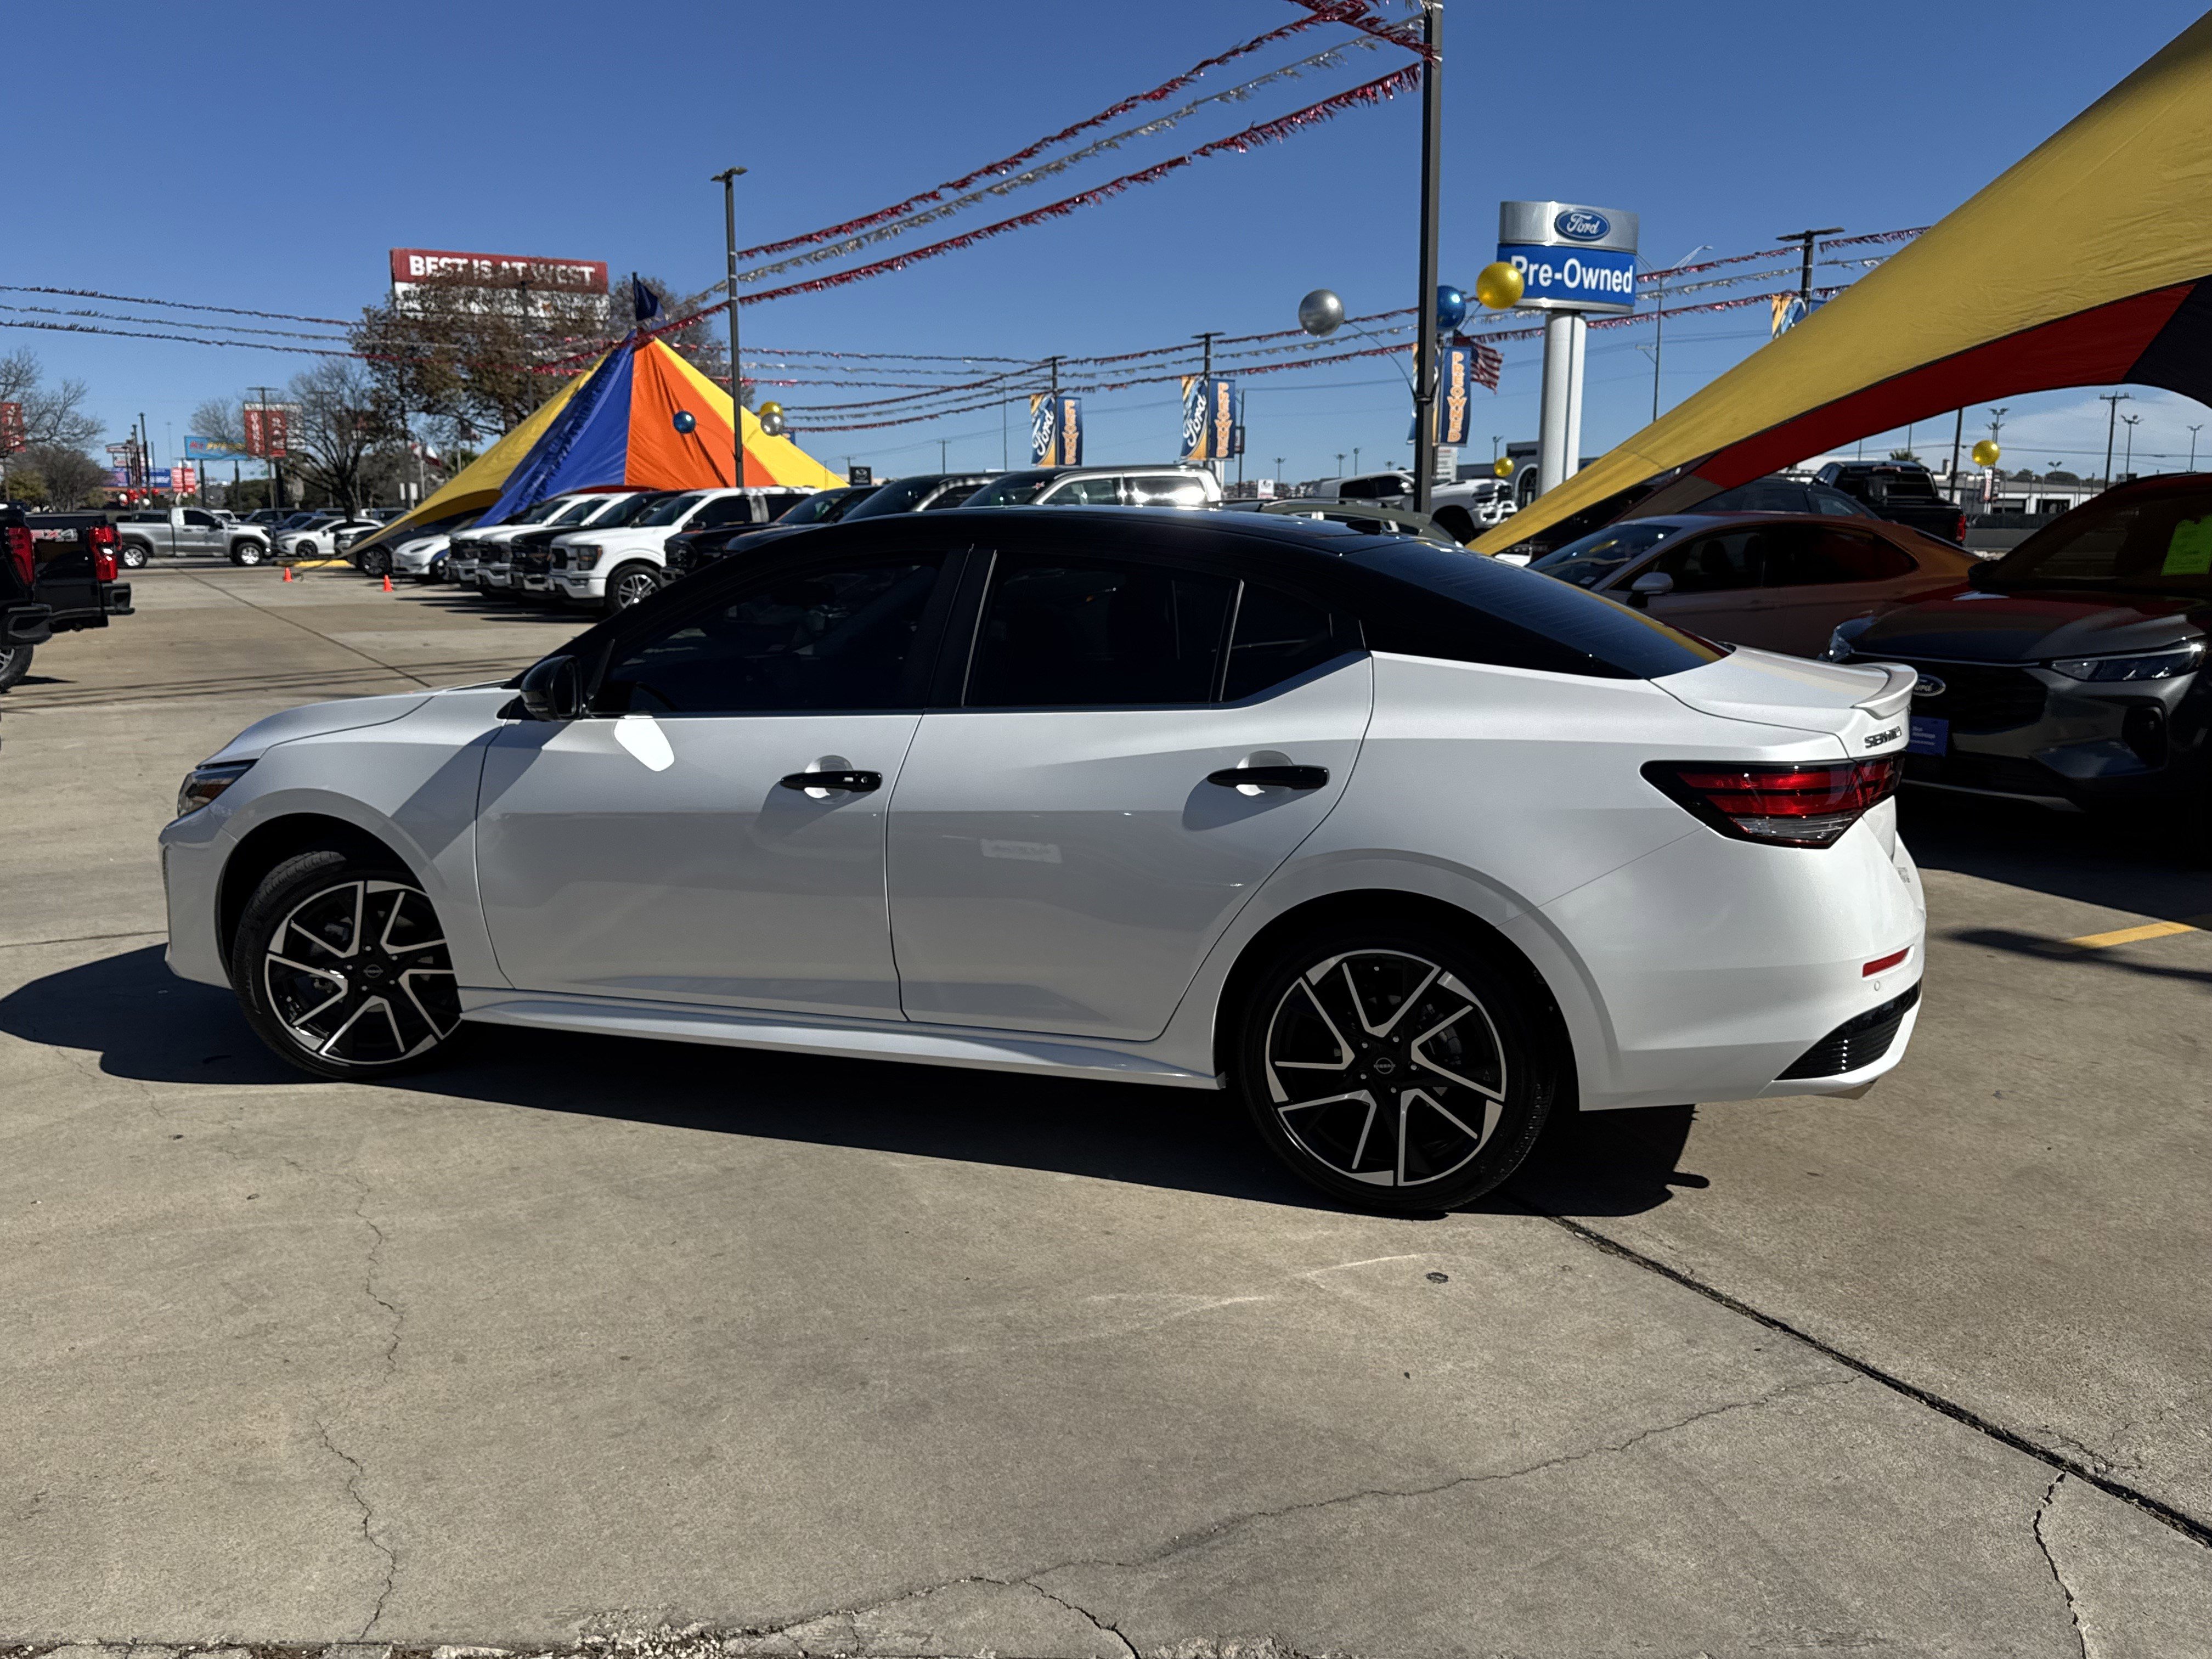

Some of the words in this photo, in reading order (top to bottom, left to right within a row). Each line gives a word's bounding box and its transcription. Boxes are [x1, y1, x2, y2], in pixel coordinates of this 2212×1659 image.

[1566, 213, 1600, 235] Ford
[409, 255, 469, 278] BEST
[472, 259, 493, 279] IS
[1510, 255, 1633, 294] Pre-Owned
[1031, 408, 1054, 456] Ford
[1183, 393, 1207, 447] Ford
